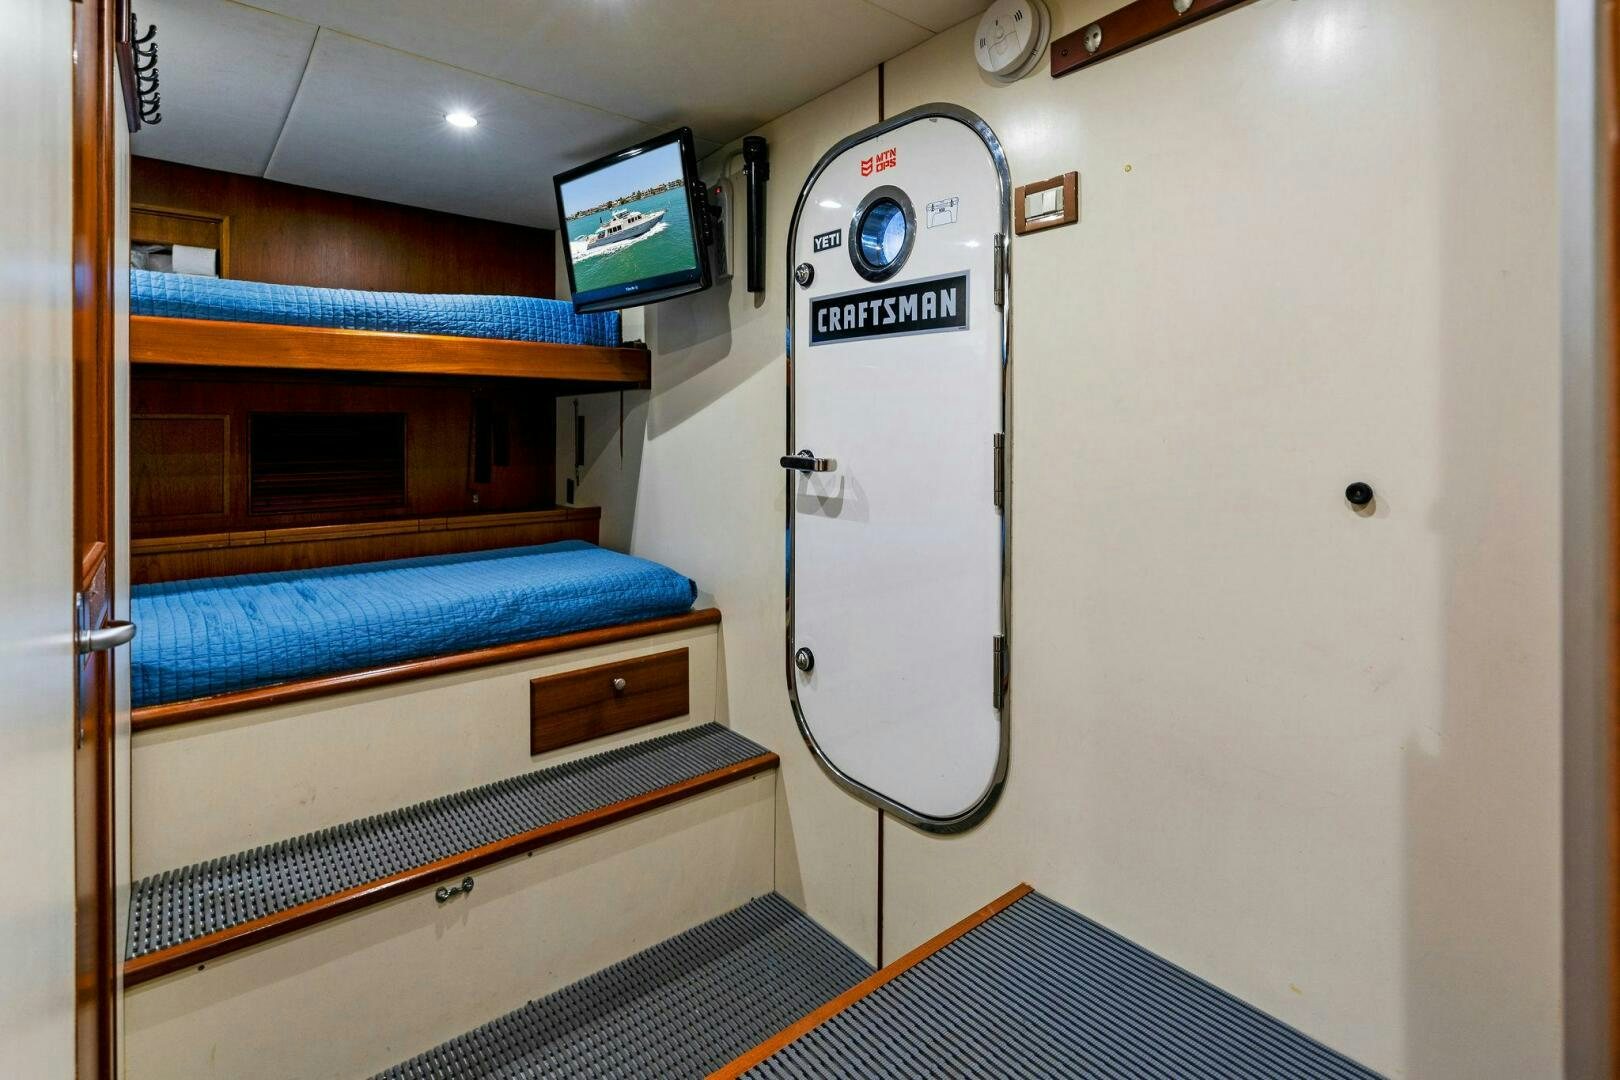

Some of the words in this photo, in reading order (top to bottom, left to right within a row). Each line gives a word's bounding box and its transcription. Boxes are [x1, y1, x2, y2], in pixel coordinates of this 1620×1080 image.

[876, 147, 896, 163] MTN
[876, 157, 896, 172] OPS
[815, 232, 840, 250] YETI
[817, 287, 957, 333] CRAFTSMAN
